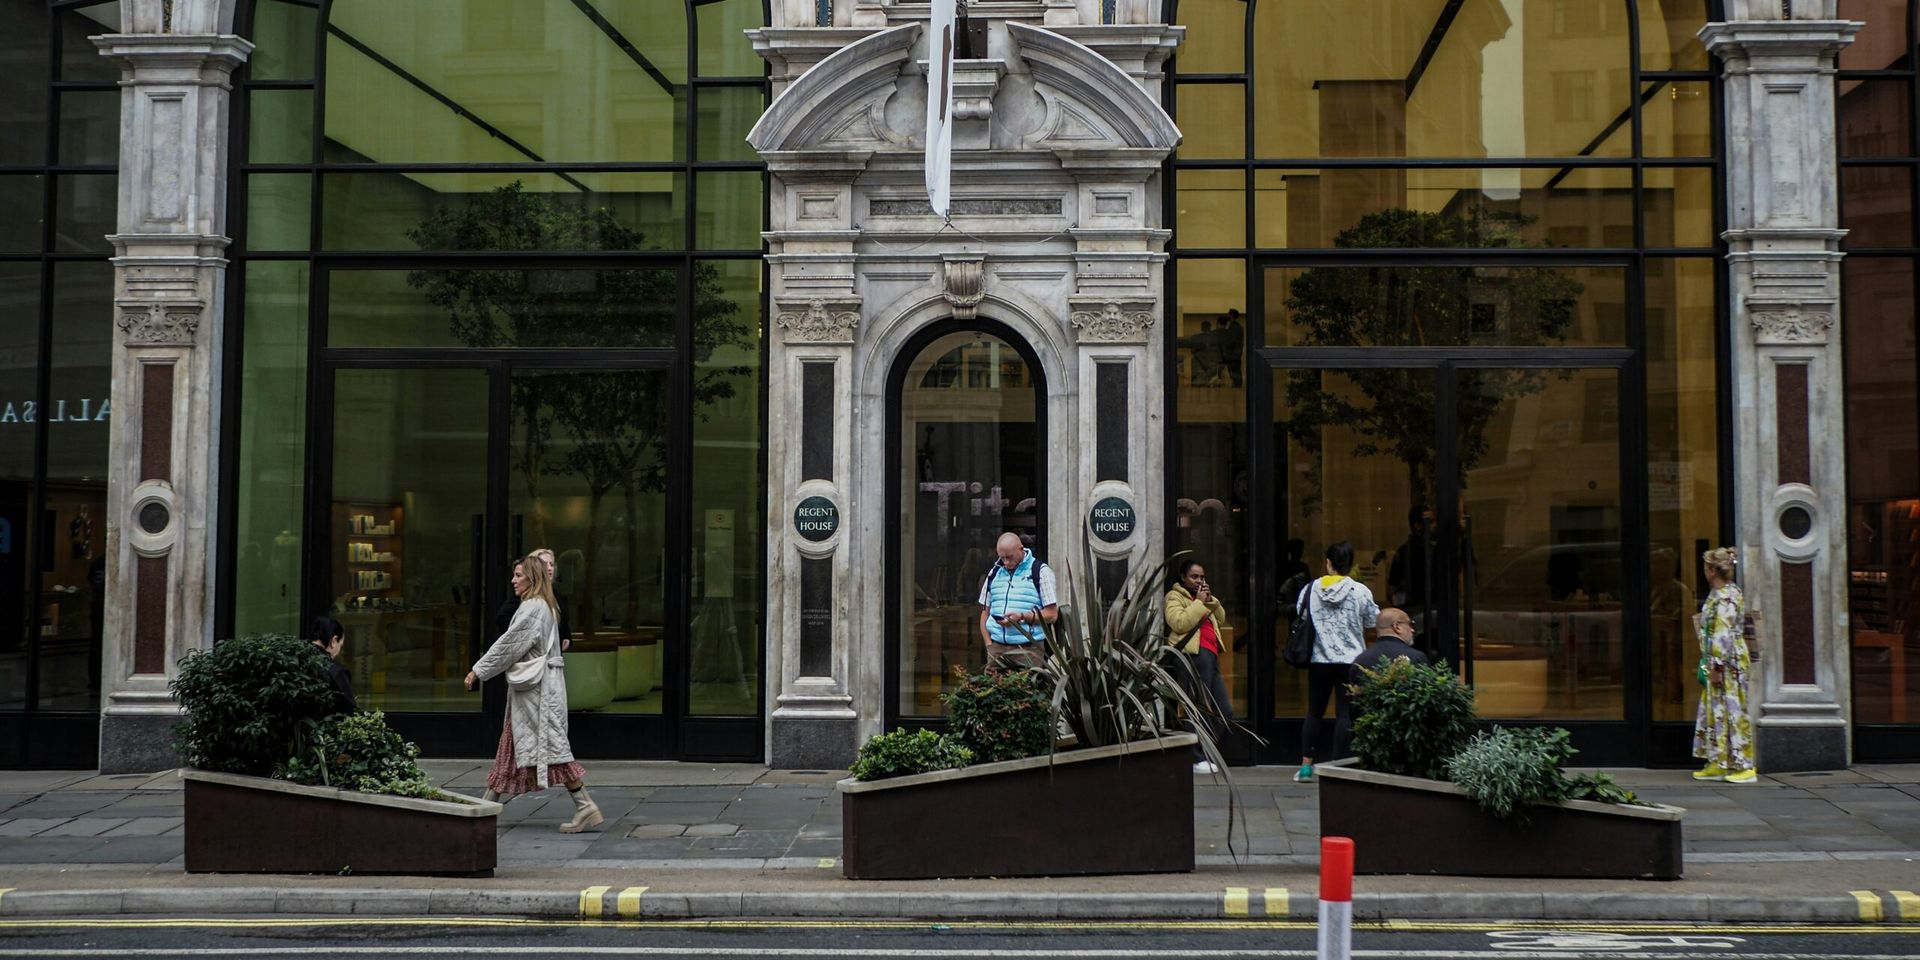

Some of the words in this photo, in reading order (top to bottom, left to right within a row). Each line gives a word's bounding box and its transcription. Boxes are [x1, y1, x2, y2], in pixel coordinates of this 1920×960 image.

[798, 507, 834, 517] REGENT
[1094, 508, 1131, 518] REGENT
[800, 521, 833, 531] HOUSE
[1096, 522, 1130, 532] HOUSE
